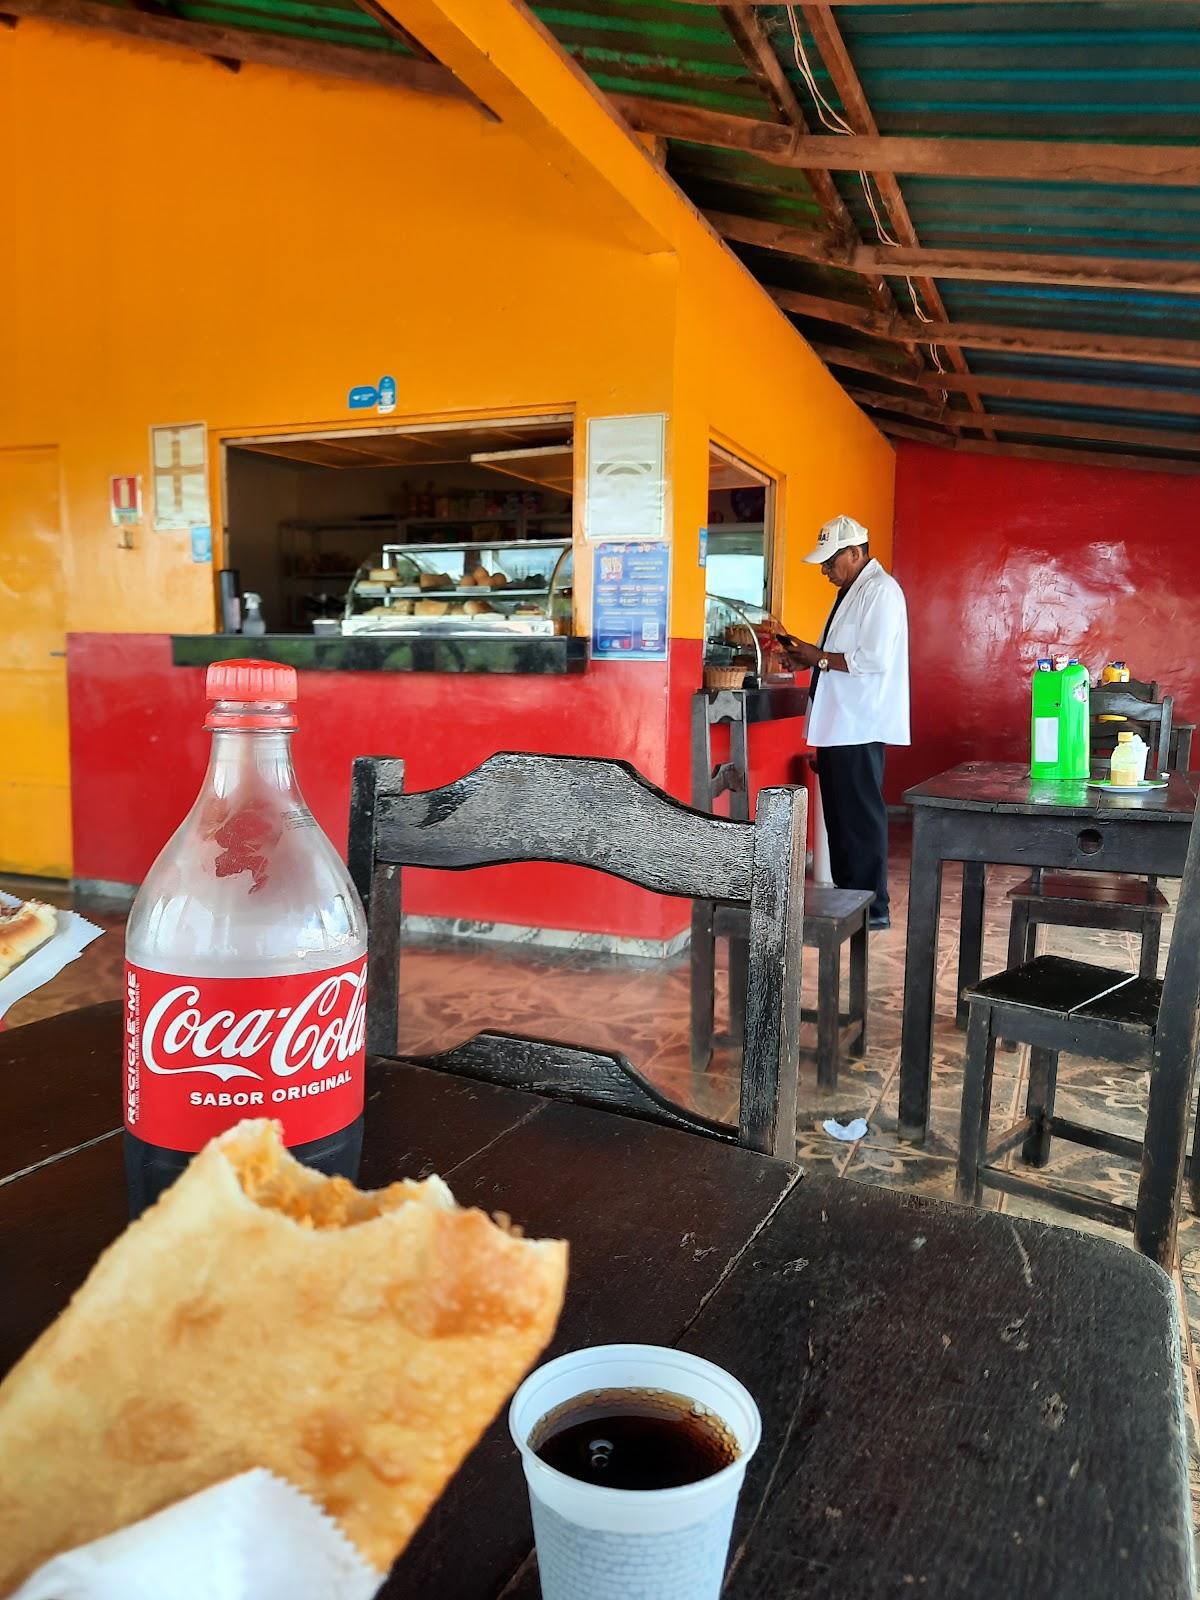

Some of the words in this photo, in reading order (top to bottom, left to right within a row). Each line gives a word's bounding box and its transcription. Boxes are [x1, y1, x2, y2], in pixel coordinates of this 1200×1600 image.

[127, 970, 138, 1125] RECICLE-ME
[142, 962, 367, 1082] Coca-Cola
[190, 1091, 264, 1107] SABOR
[271, 1070, 352, 1103] ORIGINAL
